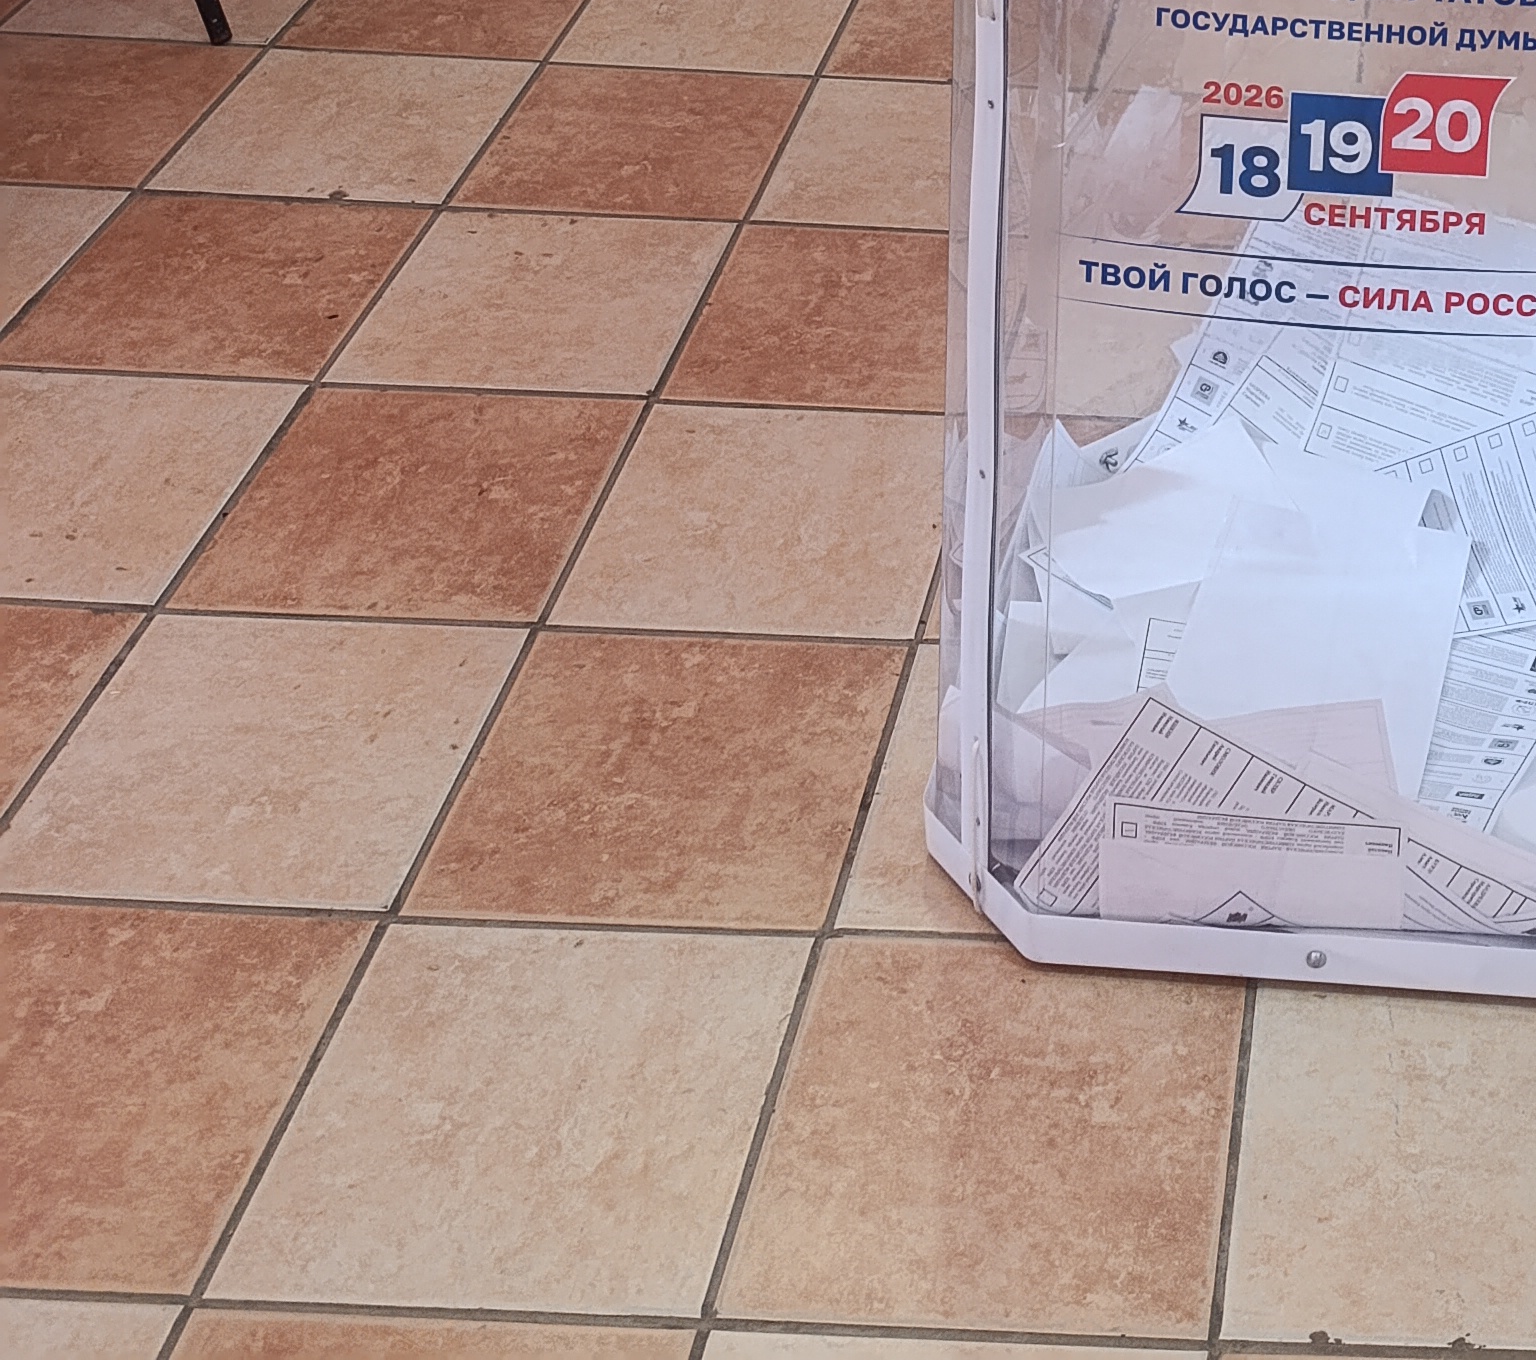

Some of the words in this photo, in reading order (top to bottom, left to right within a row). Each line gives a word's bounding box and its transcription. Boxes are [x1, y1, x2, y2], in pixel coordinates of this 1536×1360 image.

[1155, 7, 1448, 48] ГОСУДАРСТВЕННОЙ
[1202, 81, 1285, 110] 2026
[1210, 143, 1281, 198] 18
[1300, 119, 1373, 174] 19
[1391, 97, 1482, 153] 20
[1304, 202, 1486, 235] СЕНТЯБРЯ
[1078, 259, 1171, 293] ТВОЙ
[1181, 271, 1297, 304] ГОЛОС
[1338, 285, 1433, 313] СИЛА
